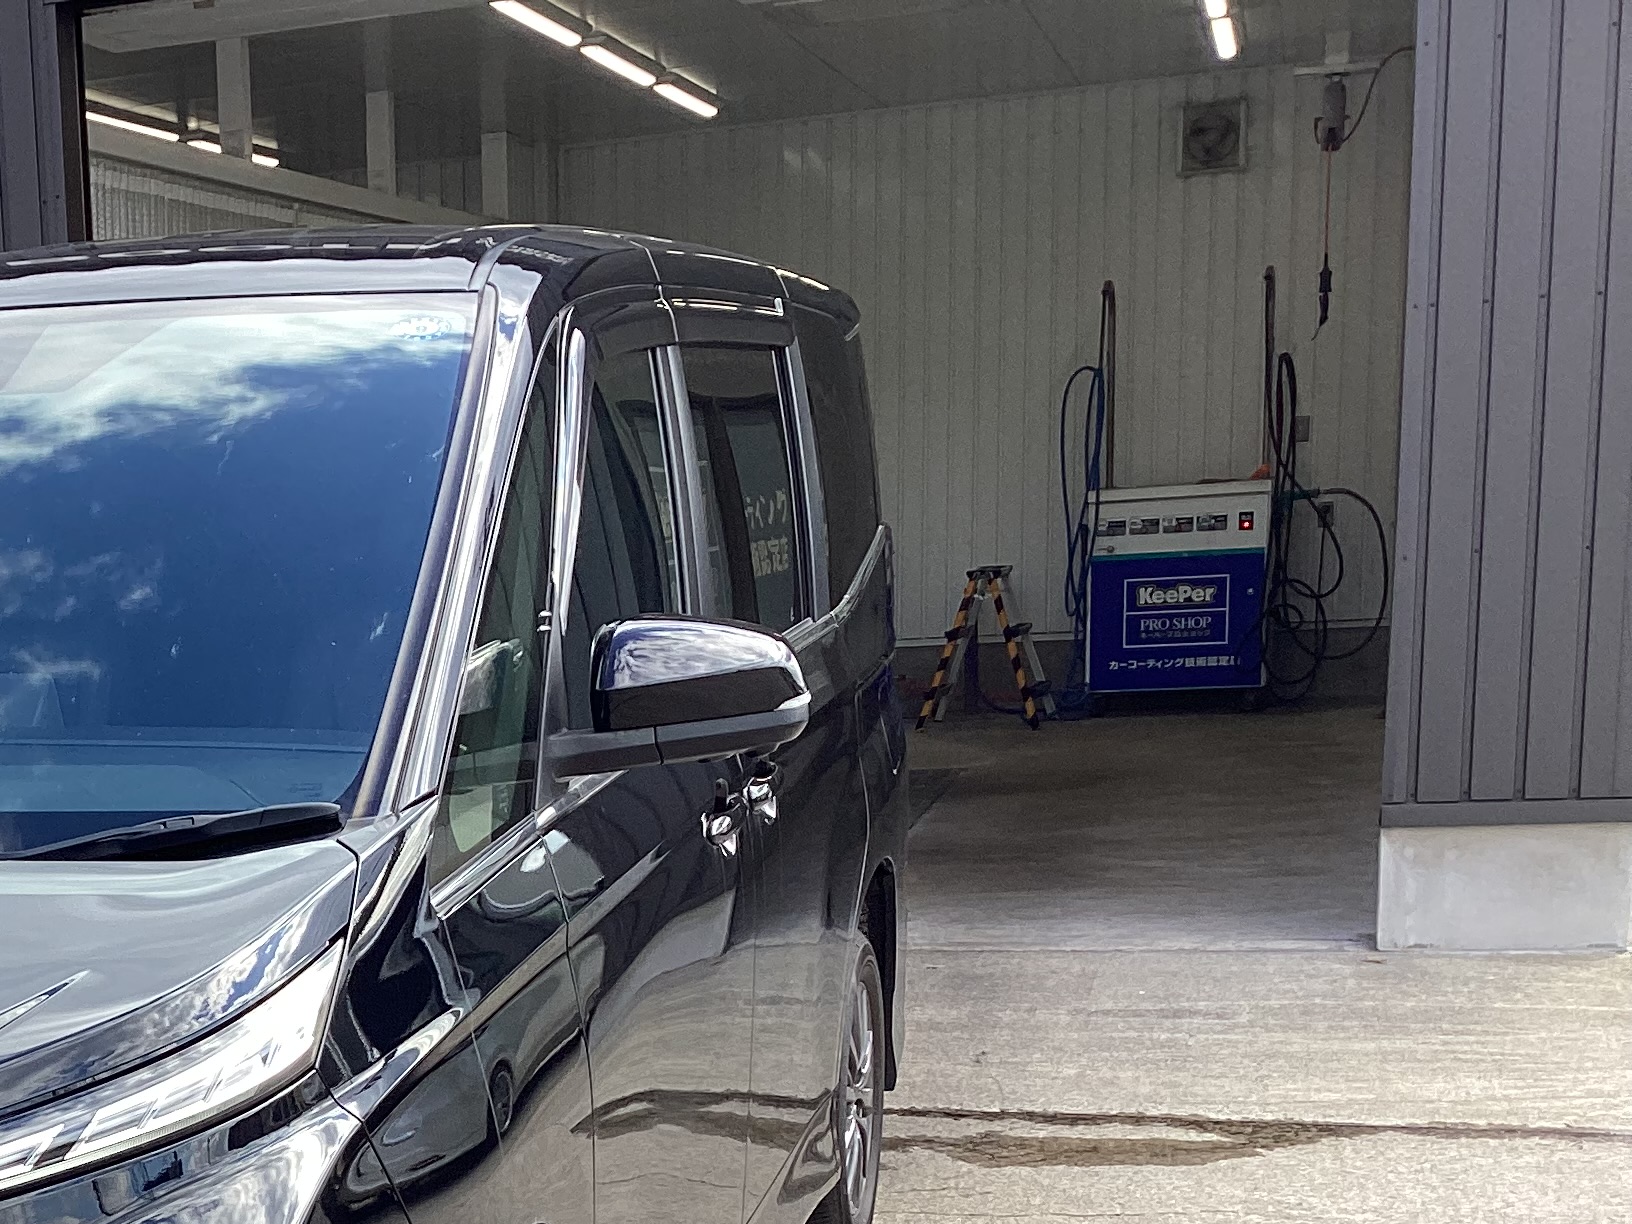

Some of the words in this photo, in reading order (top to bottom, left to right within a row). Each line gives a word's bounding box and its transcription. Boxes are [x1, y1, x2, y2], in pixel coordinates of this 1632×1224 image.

[1137, 584, 1216, 606] KeePer
[1140, 618, 1169, 631] PRO
[1172, 616, 1212, 630] SHOP
